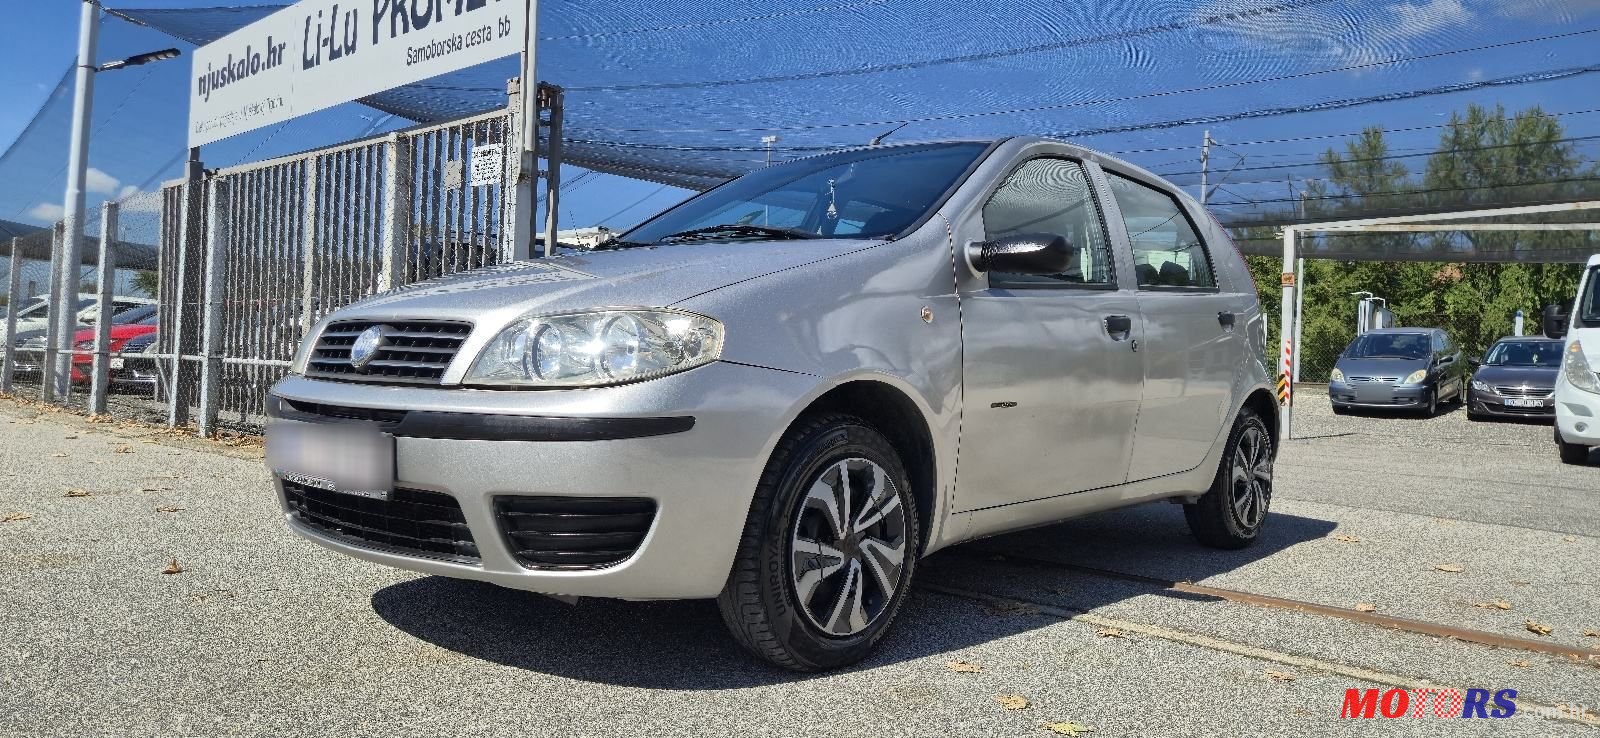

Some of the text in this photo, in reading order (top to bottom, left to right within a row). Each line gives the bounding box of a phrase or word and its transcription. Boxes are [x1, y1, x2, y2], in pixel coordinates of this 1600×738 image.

[198, 35, 287, 103] njuskalo.hr
[303, 0, 501, 70] Li-Lu PRO
[406, 14, 511, 66] Samoborska cesta bb
[768, 527, 787, 617] UNIROYAL
